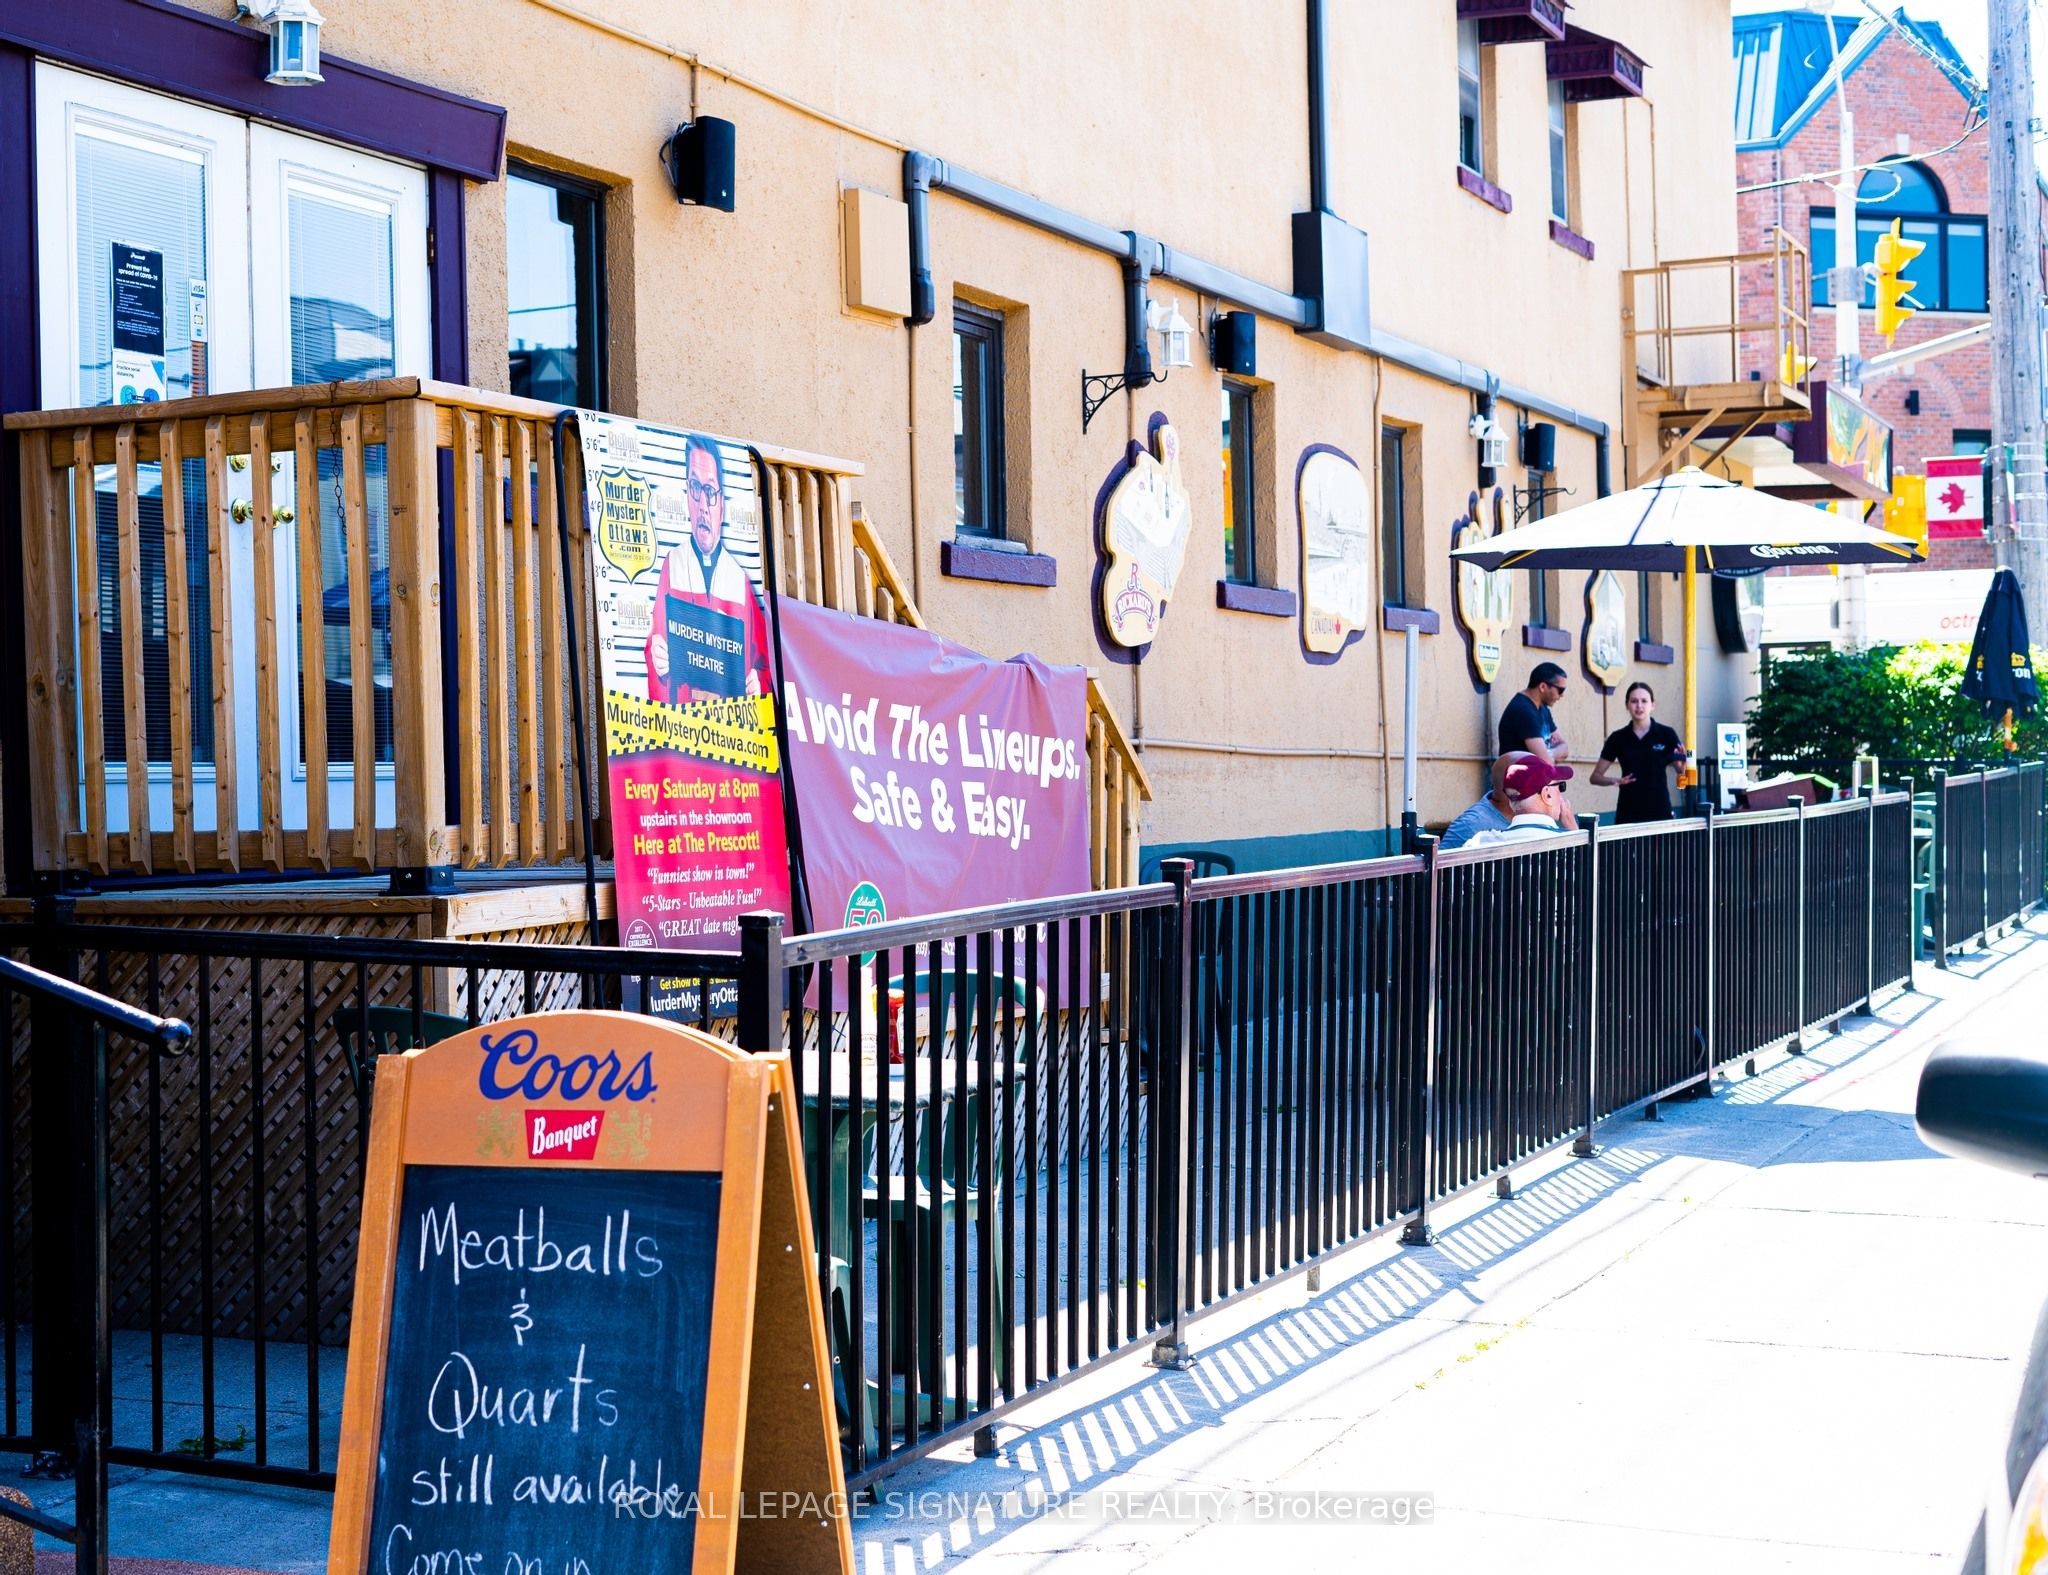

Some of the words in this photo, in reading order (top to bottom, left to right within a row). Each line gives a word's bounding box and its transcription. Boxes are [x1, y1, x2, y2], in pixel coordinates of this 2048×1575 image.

[605, 481, 645, 502] Murder
[606, 502, 646, 524] Mystery
[608, 523, 648, 544] Ottawa
[1749, 545, 1838, 559] Corona
[1940, 612, 1977, 629] octr
[668, 619, 704, 644] MURDER
[705, 631, 743, 656] MYSTERY
[687, 651, 725, 675] THEATRE
[607, 702, 769, 759] MurderMysteryOttawa.com
[786, 681, 879, 756] Avoid
[888, 703, 949, 766] The
[957, 713, 1081, 788] Lineups.
[624, 778, 659, 805] Every
[662, 777, 716, 804] Saturday
[719, 779, 730, 798] at
[732, 777, 759, 803] 8pm
[640, 809, 678, 831] upstairs
[678, 810, 688, 826] in
[689, 809, 703, 825] the
[705, 809, 752, 825] showroom
[850, 766, 923, 831] Safe
[930, 777, 956, 833] &
[961, 780, 1031, 851] Easy.
[633, 833, 665, 855] Here
[667, 834, 682, 854] at
[683, 832, 705, 853] The
[707, 830, 760, 852] Prescott!
[692, 865, 713, 882] show
[714, 864, 724, 881] in
[689, 889, 735, 909] Unbeatable
[703, 917, 720, 935] date
[660, 978, 672, 990] Get
[672, 977, 691, 989] show
[479, 1029, 658, 1103] Coors
[532, 1114, 598, 1156] Banquet
[419, 1201, 664, 1286] Meatballs
[427, 1343, 619, 1440] Quarts
[411, 1454, 493, 1505] still
[513, 1454, 683, 1518] available
[385, 1524, 483, 1575] Come
[505, 1551, 542, 1575] on
